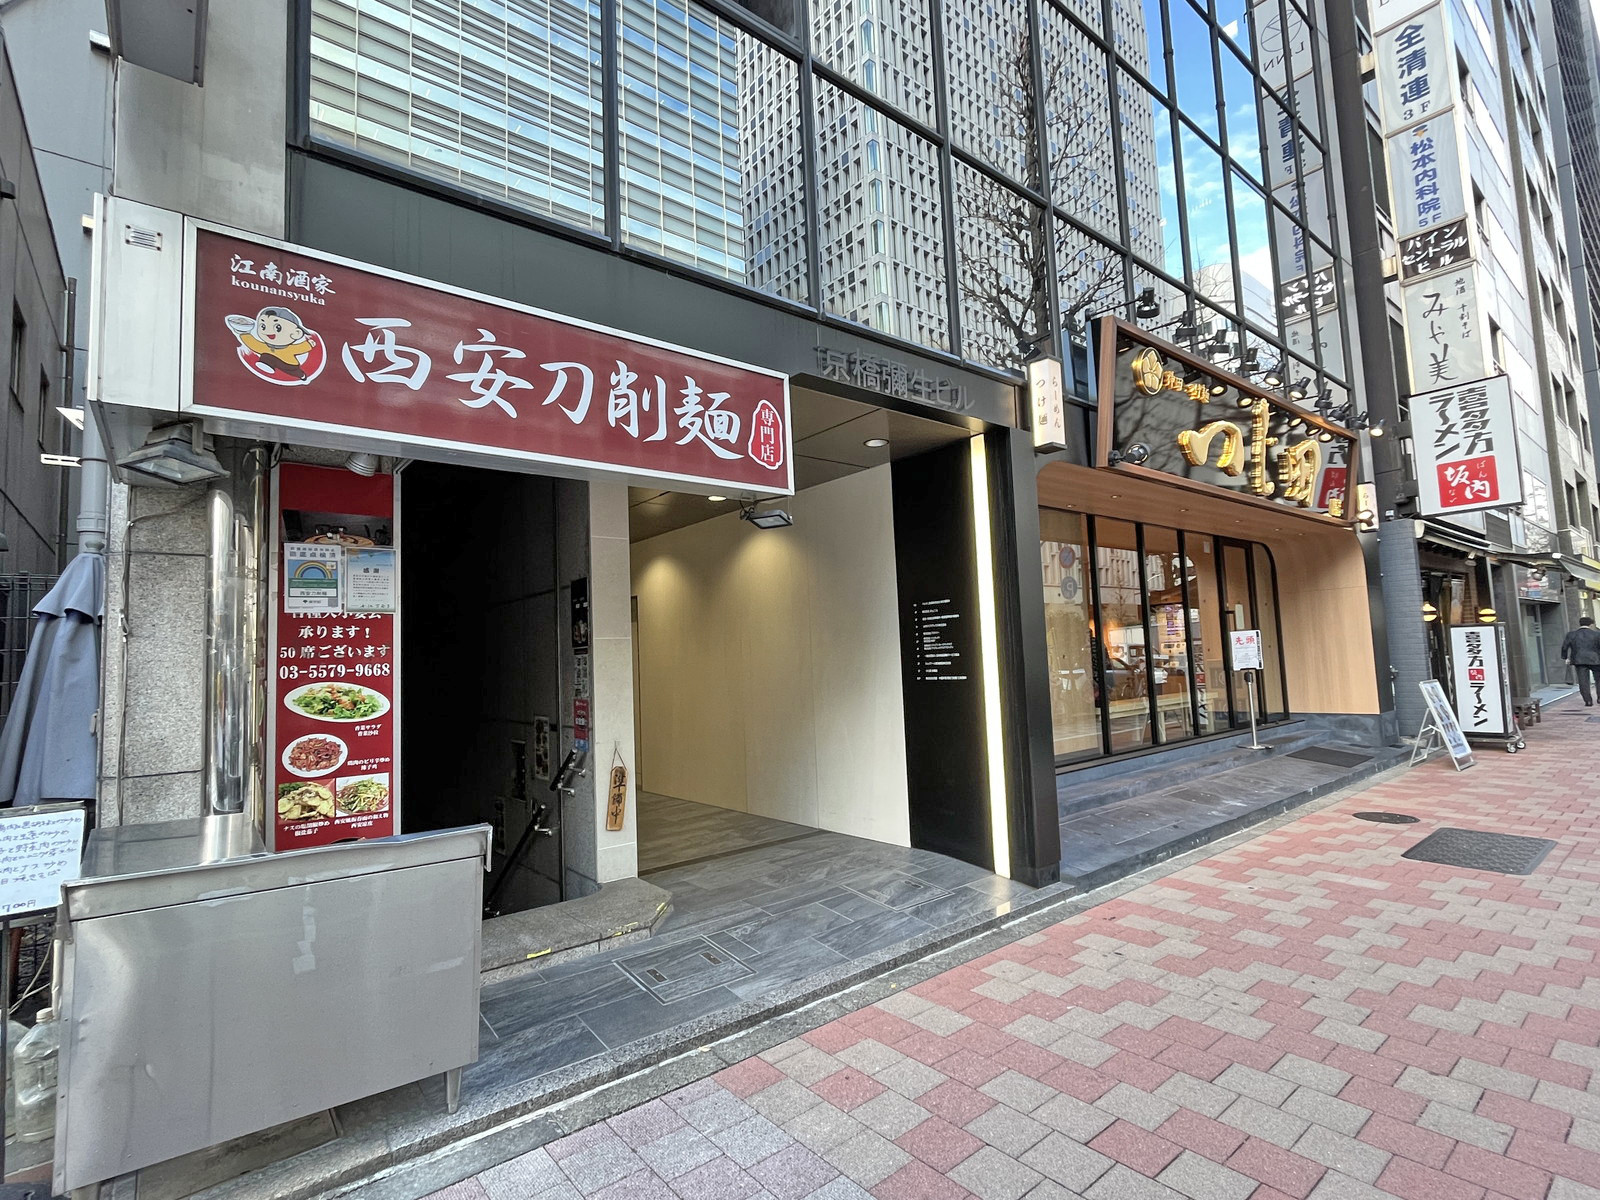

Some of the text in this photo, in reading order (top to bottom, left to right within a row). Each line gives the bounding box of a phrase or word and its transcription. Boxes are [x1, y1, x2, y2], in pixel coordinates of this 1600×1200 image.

[1394, 22, 1431, 107] 全清連
[1402, 100, 1431, 121] 3F
[1410, 136, 1441, 217] 松本内科院
[1418, 212, 1442, 228] 5F
[1401, 236, 1468, 265] セントラル
[1417, 254, 1454, 274] ビル
[230, 253, 336, 295] 江南酒家
[231, 275, 326, 306] kounansyuka
[1422, 293, 1459, 385] みや美
[341, 317, 746, 461] 西安刀削麺
[759, 408, 776, 463] 専門店
[1429, 392, 1460, 461] ラーメン
[1457, 385, 1494, 456] 喜多方
[1444, 465, 1490, 499] 坂内
[279, 644, 390, 659] 50 席ございます
[1465, 631, 1484, 667] 喜多方
[279, 663, 391, 679] 03-5579-9668
[1469, 682, 1488, 727] ラーメン
[611, 774, 626, 825] 準備中
